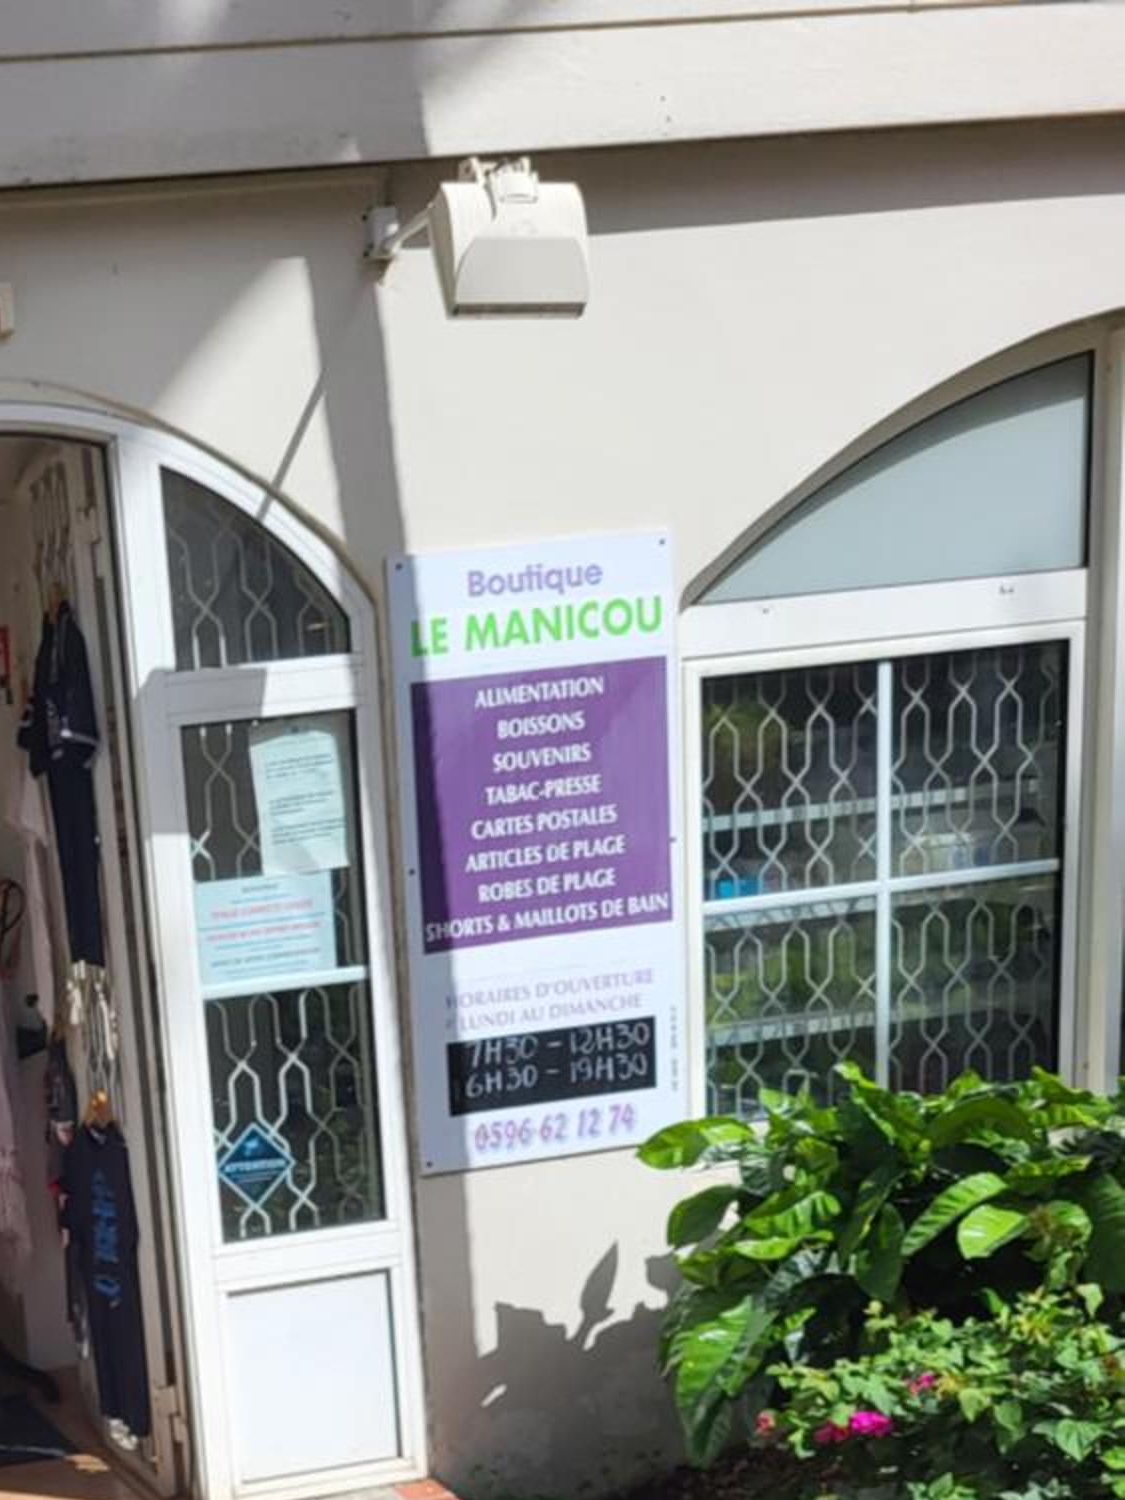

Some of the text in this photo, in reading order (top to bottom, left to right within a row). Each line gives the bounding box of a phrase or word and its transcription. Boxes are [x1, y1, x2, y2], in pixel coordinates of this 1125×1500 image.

[467, 562, 604, 597] Boutique
[411, 595, 662, 657] LE MANICOU
[475, 676, 604, 708] ALIMENTATION
[497, 711, 585, 739] BOISSONS
[492, 743, 592, 773] SOUVENIRS
[485, 773, 602, 805] TABAC-PRESSE
[471, 804, 618, 840] CARTES POSTALES
[465, 834, 626, 872] ARTICLES DE PLAGE
[478, 867, 616, 903] ROBES DE PLAGE
[426, 893, 669, 943] SHORTS & MAILLOTS DE BAIN
[446, 970, 653, 1009] HORAIRES D'OUVERTURE
[520, 1006, 545, 1023] AU
[549, 993, 642, 1018] DIMANCHE
[570, 1022, 650, 1054] 12H30
[465, 1065, 538, 1098] 6H30
[570, 1052, 648, 1083] 19H30
[539, 1112, 568, 1143] 62
[577, 1106, 601, 1139] 12
